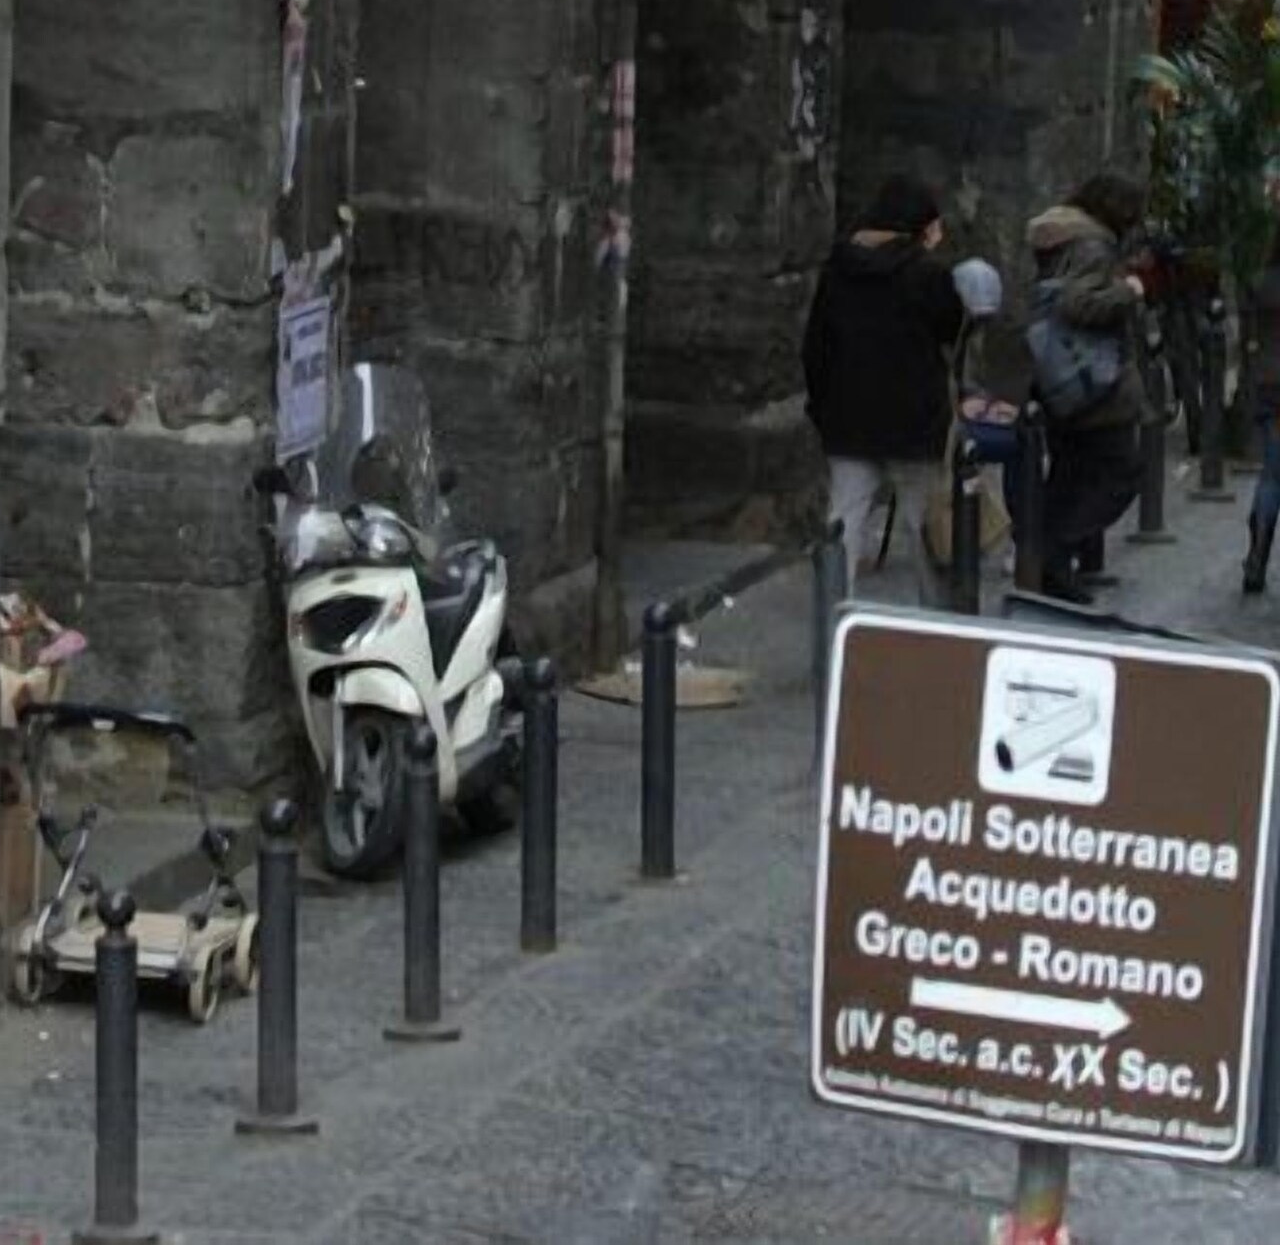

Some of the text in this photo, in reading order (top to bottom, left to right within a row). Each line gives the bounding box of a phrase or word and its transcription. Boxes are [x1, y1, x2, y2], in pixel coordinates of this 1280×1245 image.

[839, 784, 1239, 881] Napoli Sotterranea
[904, 856, 1157, 932] Acquedotto
[855, 910, 1204, 1001] Greco - Romano
[835, 1007, 885, 1057] (IV
[892, 1016, 968, 1067] Sec.
[975, 1038, 1044, 1078] a.c.
